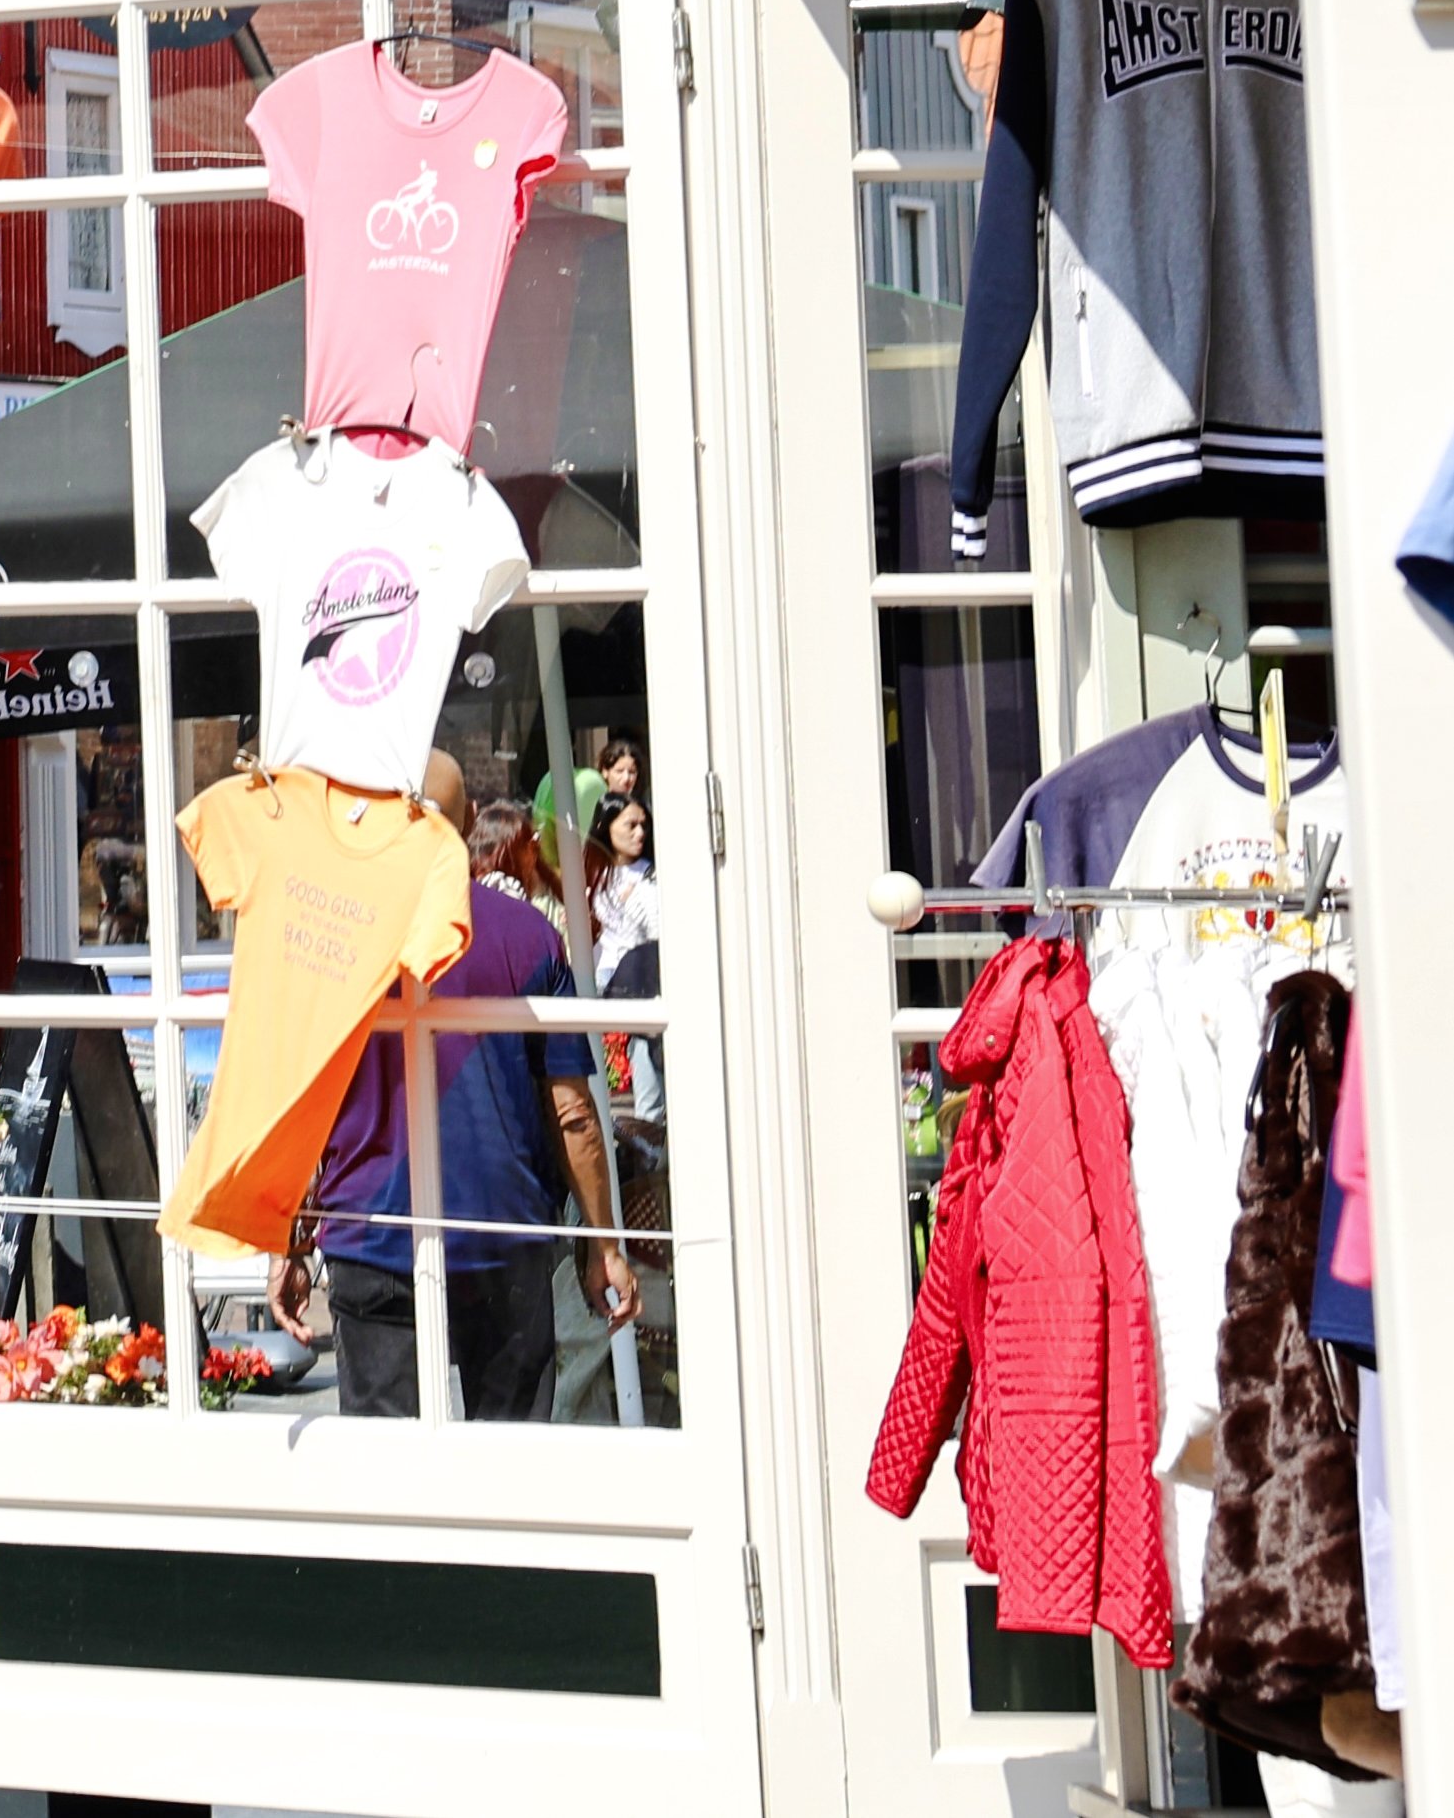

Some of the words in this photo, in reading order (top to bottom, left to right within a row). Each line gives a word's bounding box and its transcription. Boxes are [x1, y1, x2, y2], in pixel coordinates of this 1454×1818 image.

[366, 255, 449, 276] AMSTERDAM
[302, 578, 411, 626] Amsterdam
[285, 876, 328, 911] GOOD
[330, 895, 377, 926] GIRLS
[284, 921, 313, 952] BAD
[315, 934, 358, 968] GIRLS
